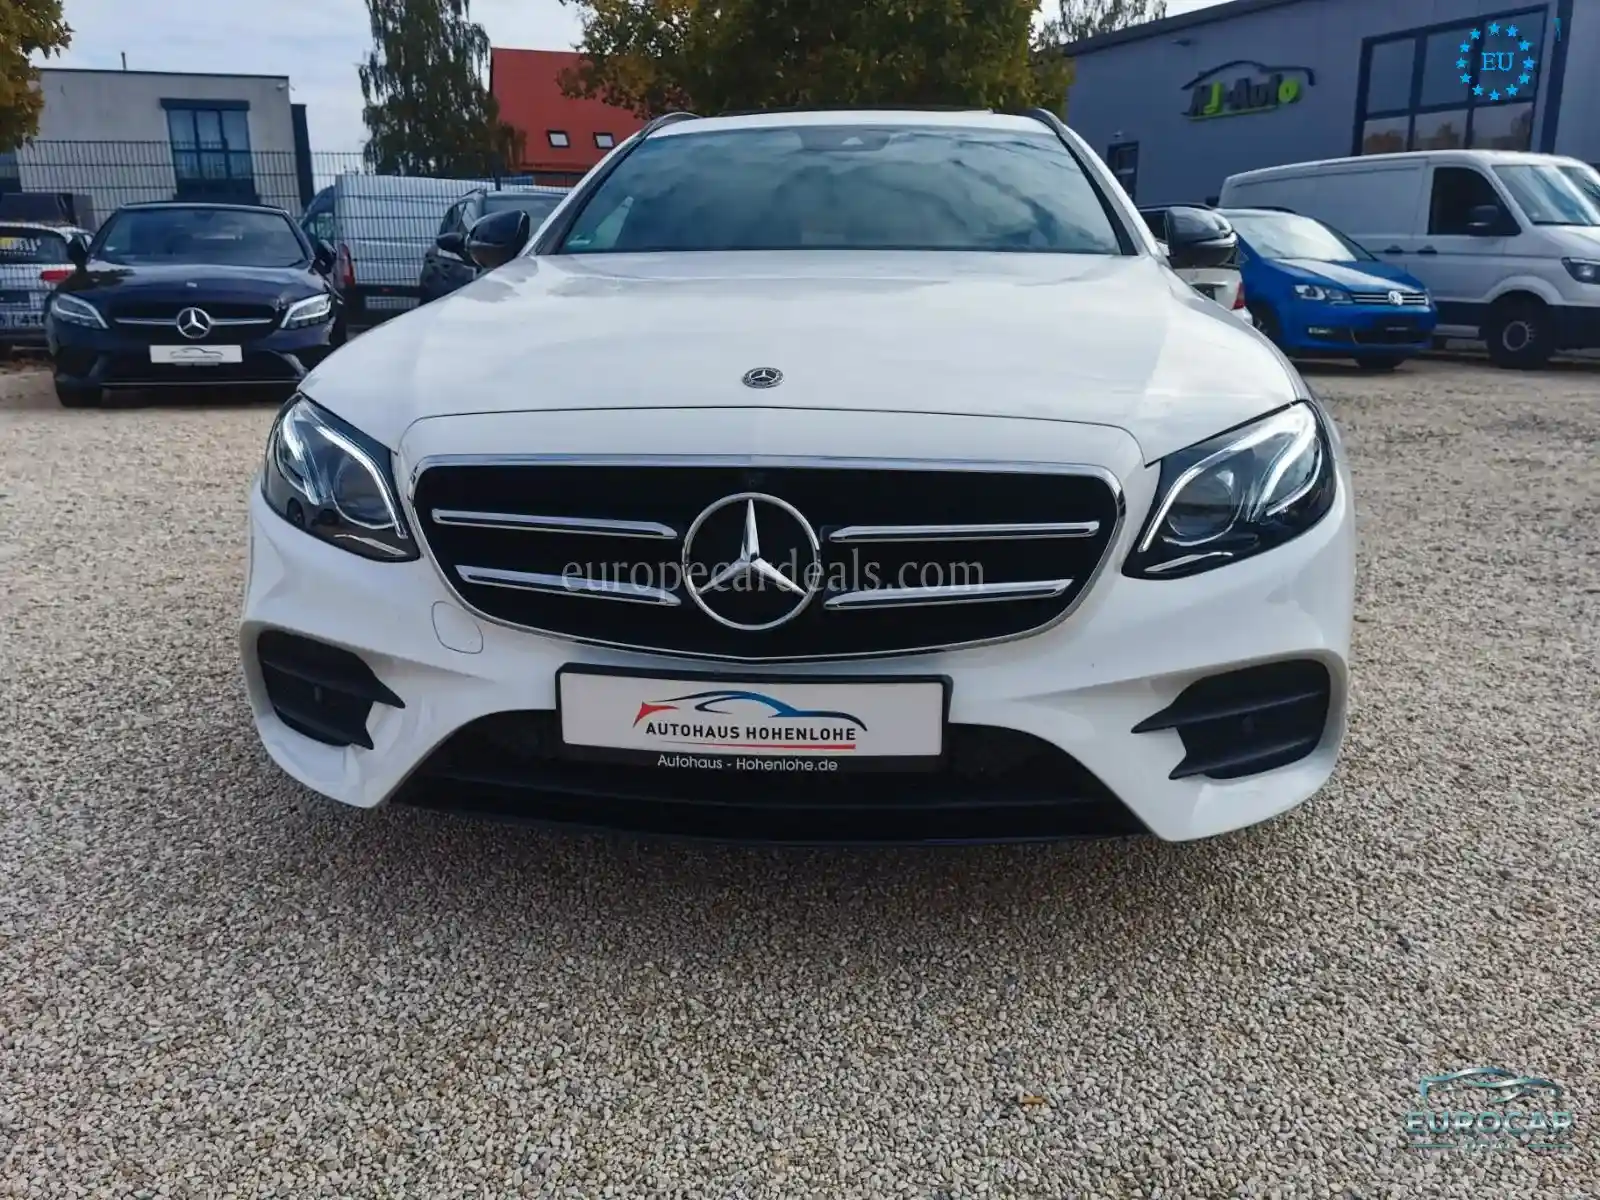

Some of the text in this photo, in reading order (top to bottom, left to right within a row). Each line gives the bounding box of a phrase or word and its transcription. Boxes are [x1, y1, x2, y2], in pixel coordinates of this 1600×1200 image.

[645, 721, 857, 741] AUTOHAUS HOHENLOHE
[657, 754, 723, 769] Autohaus
[736, 757, 839, 772] Hohenlohe.de
